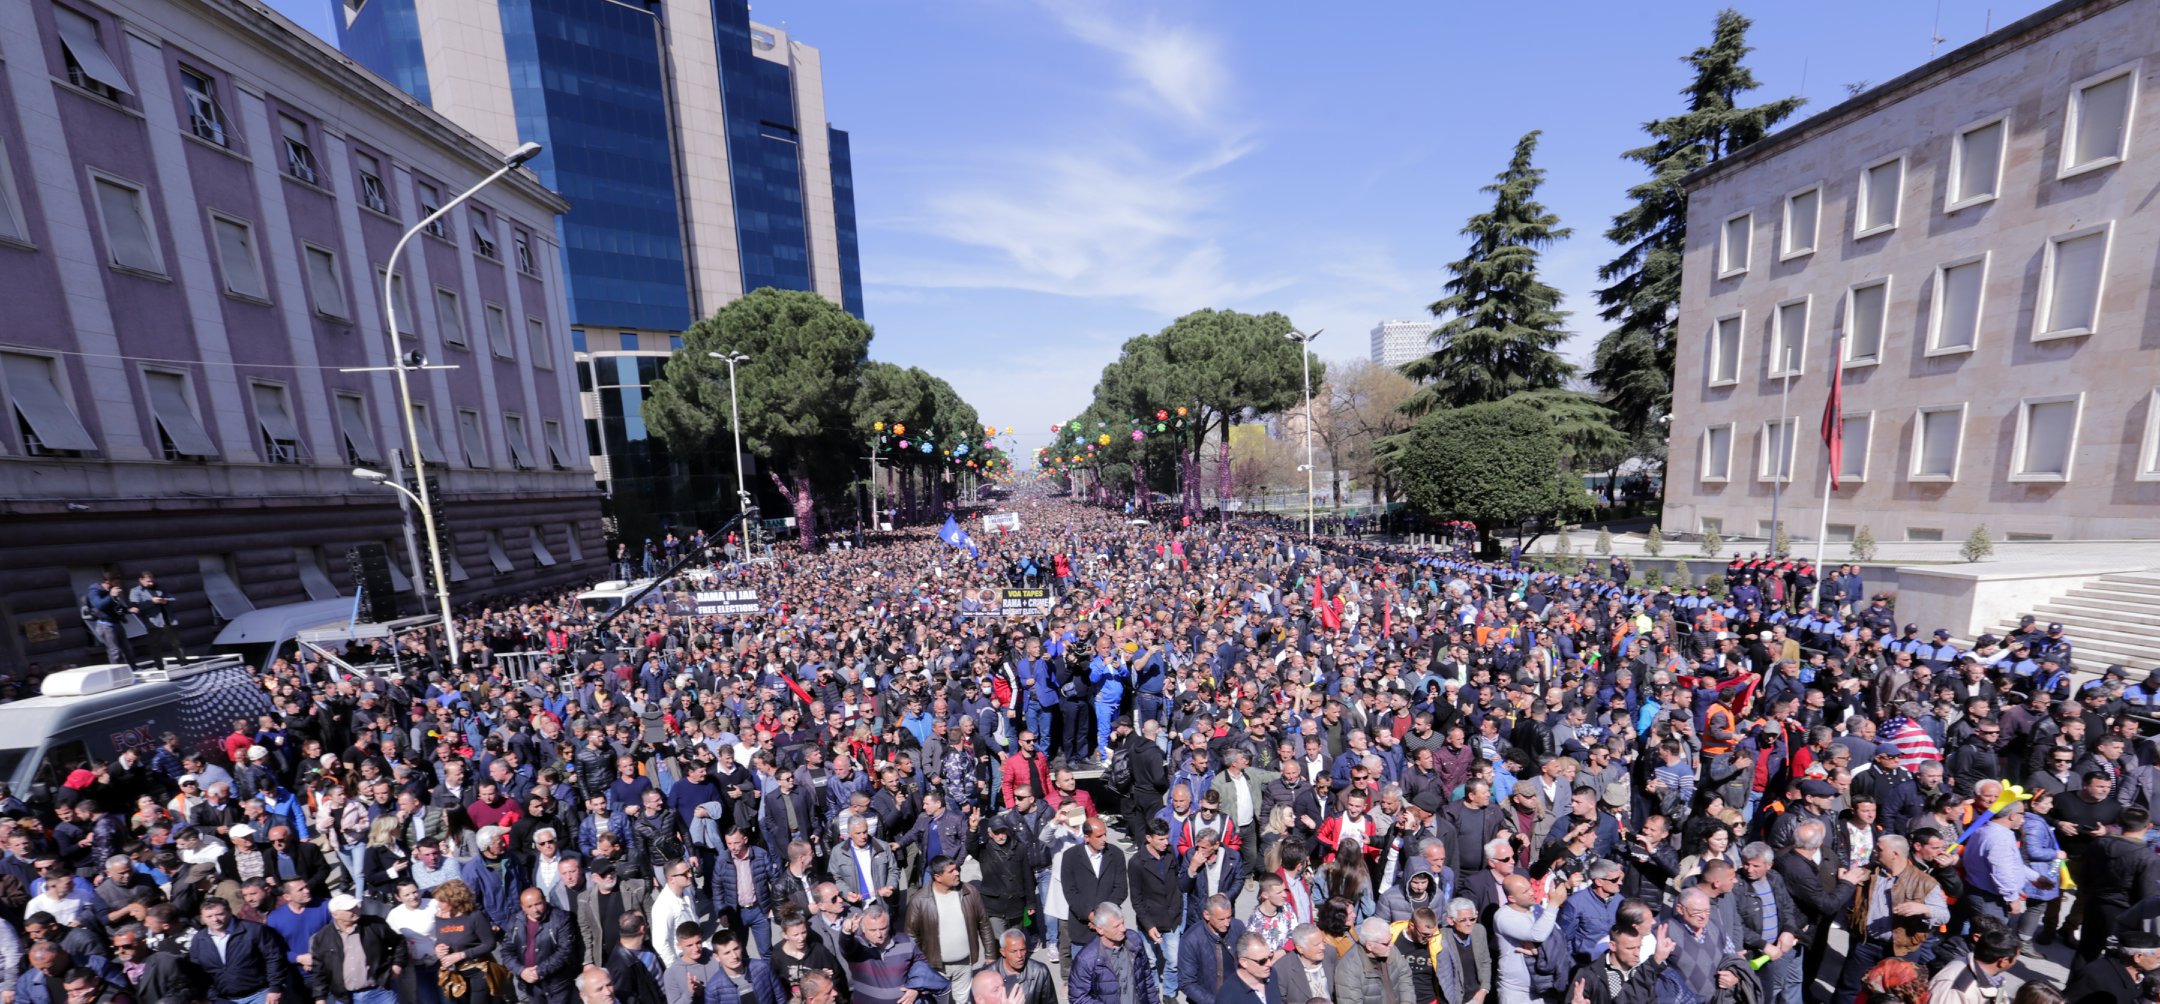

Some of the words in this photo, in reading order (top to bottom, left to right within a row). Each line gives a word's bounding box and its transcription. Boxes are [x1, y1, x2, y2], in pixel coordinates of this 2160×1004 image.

[696, 592, 725, 602] RAMA
[726, 591, 737, 601] IN
[738, 590, 758, 600] JAIL
[698, 605, 716, 614] FREE
[717, 603, 759, 613] ELECTIONS
[1002, 598, 1022, 608] RAMA
